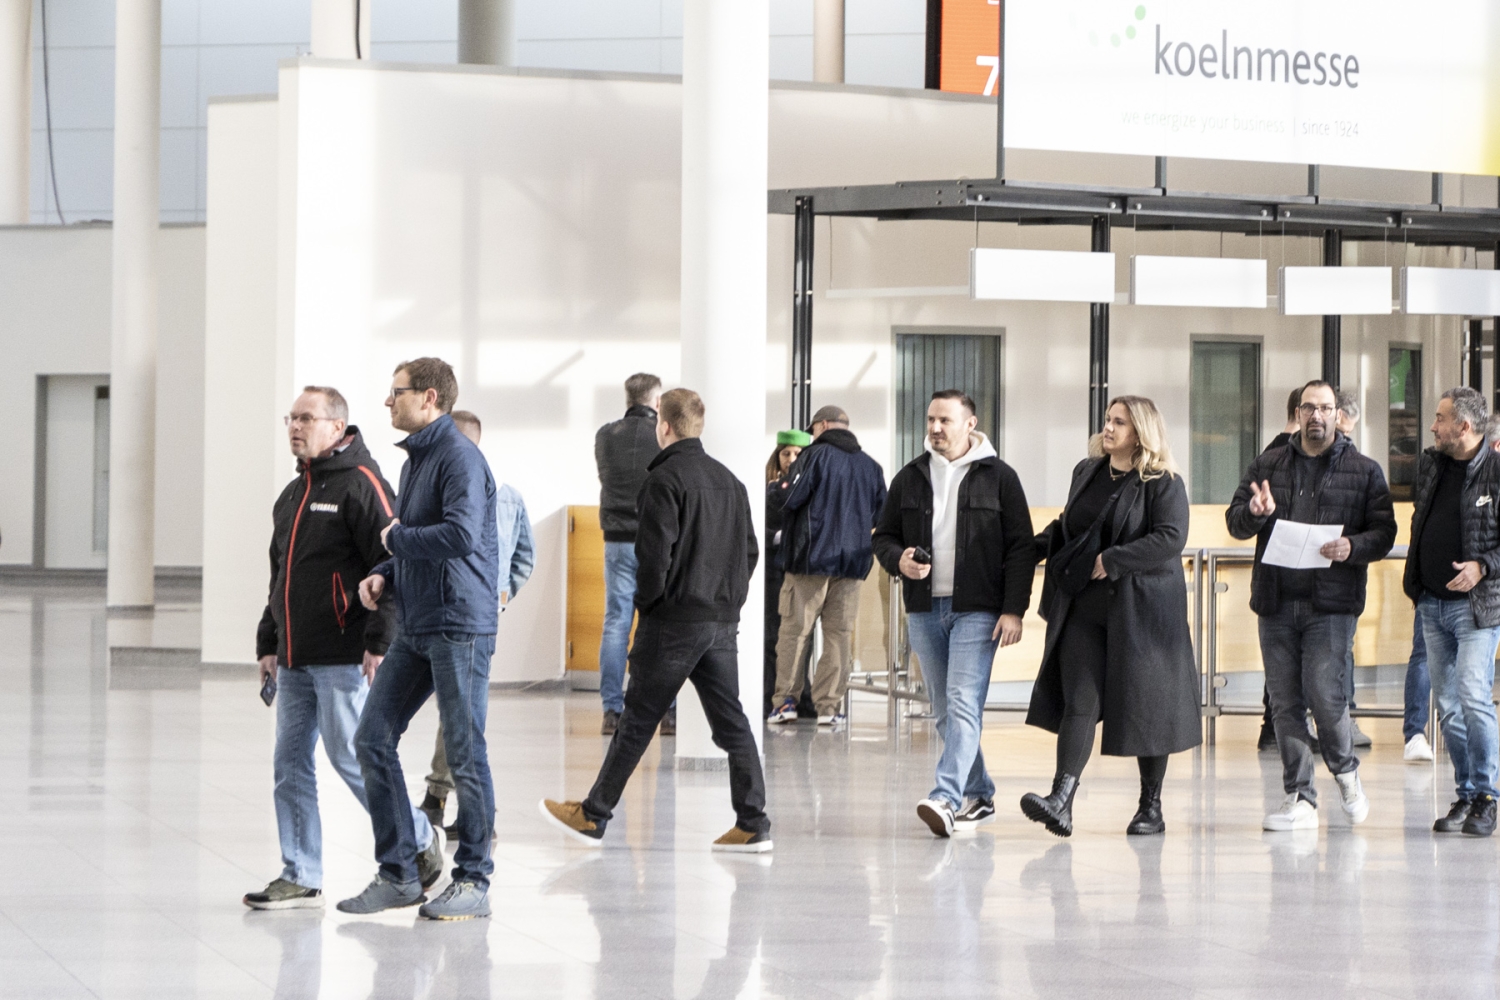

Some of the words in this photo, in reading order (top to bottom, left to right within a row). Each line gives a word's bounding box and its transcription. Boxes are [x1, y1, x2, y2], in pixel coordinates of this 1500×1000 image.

[1154, 24, 1360, 89] koelnmesse
[1120, 111, 1139, 126] we
[1143, 111, 1197, 133] energize
[1200, 116, 1229, 133] your
[1233, 113, 1285, 134] business
[1302, 118, 1330, 136] since
[1334, 120, 1359, 138] 1924
